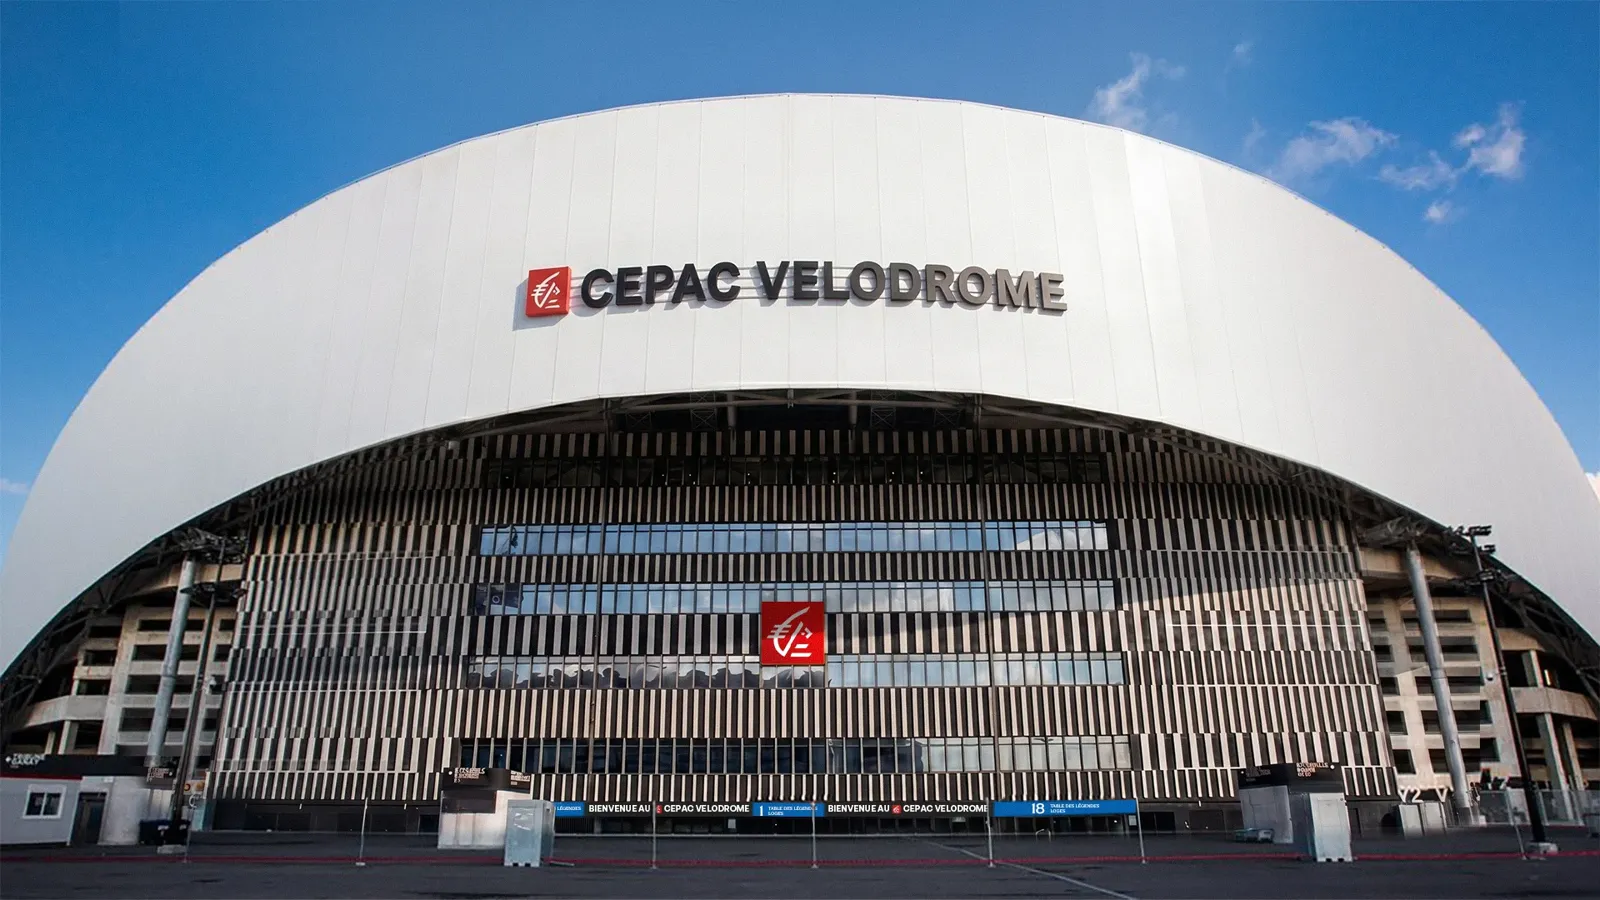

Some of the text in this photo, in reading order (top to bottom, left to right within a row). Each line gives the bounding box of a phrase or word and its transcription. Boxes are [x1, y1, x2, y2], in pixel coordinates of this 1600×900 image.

[580, 260, 1068, 312] CEPAC VELODROME
[588, 804, 750, 813] BIENVENUE AU CEPAC VELODROME
[759, 805, 764, 816] 1
[828, 804, 988, 813] BIENVENUE AU CEPAC VELODROME
[1031, 803, 1045, 814] 18
